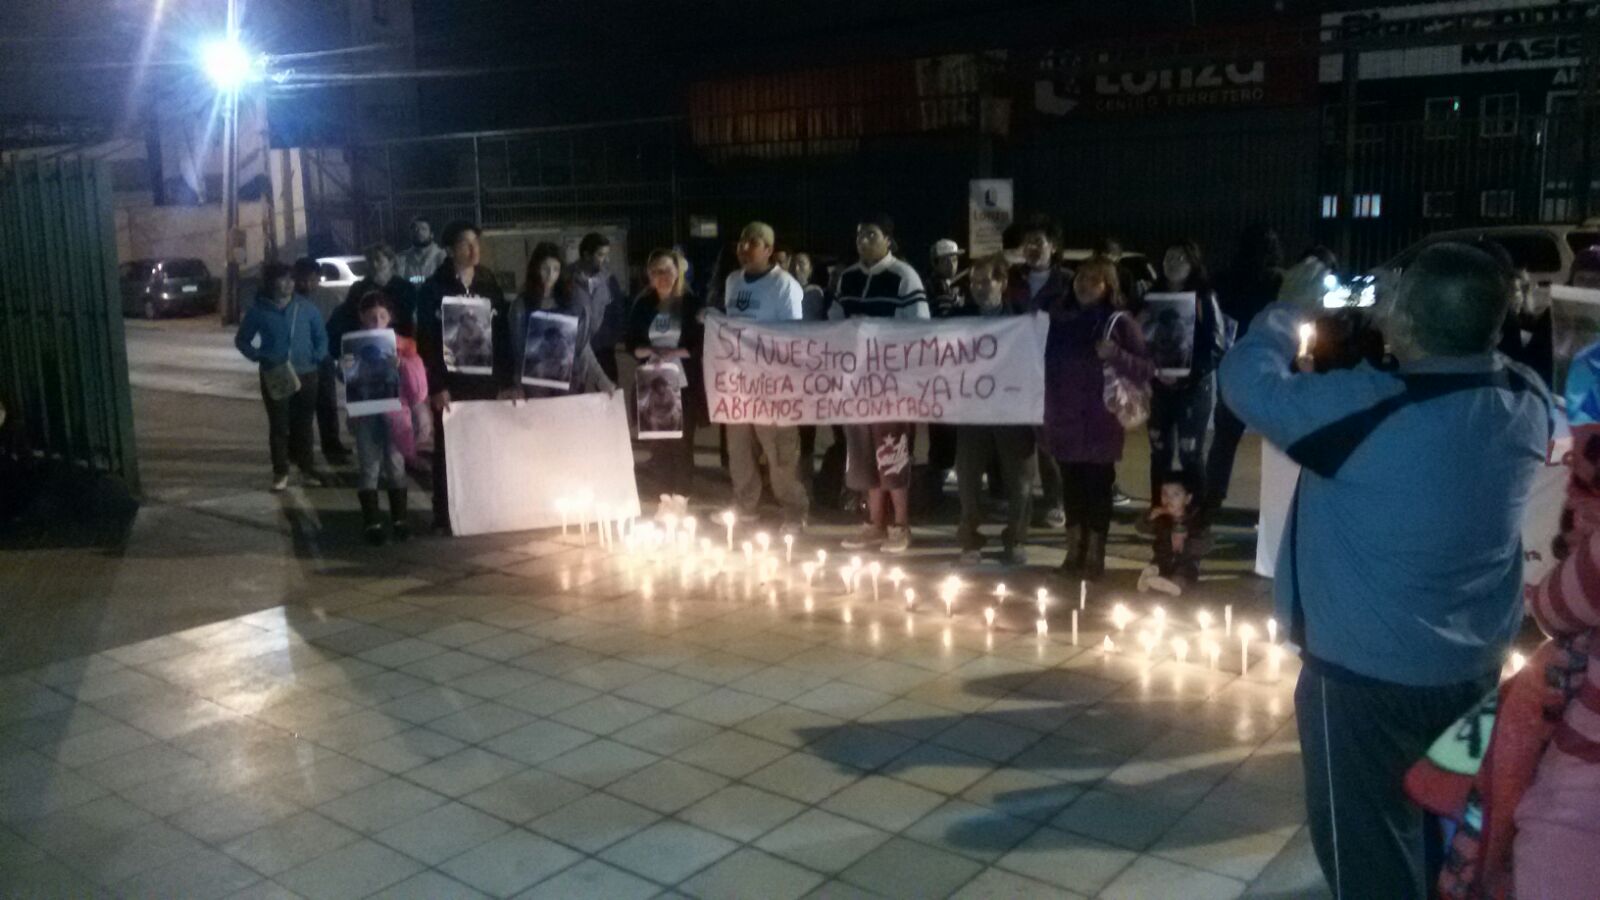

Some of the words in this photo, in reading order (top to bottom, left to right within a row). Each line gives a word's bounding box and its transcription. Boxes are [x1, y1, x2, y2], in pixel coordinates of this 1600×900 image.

[715, 323, 747, 363] SI
[803, 373, 844, 396] CON
[960, 370, 996, 399] LO
